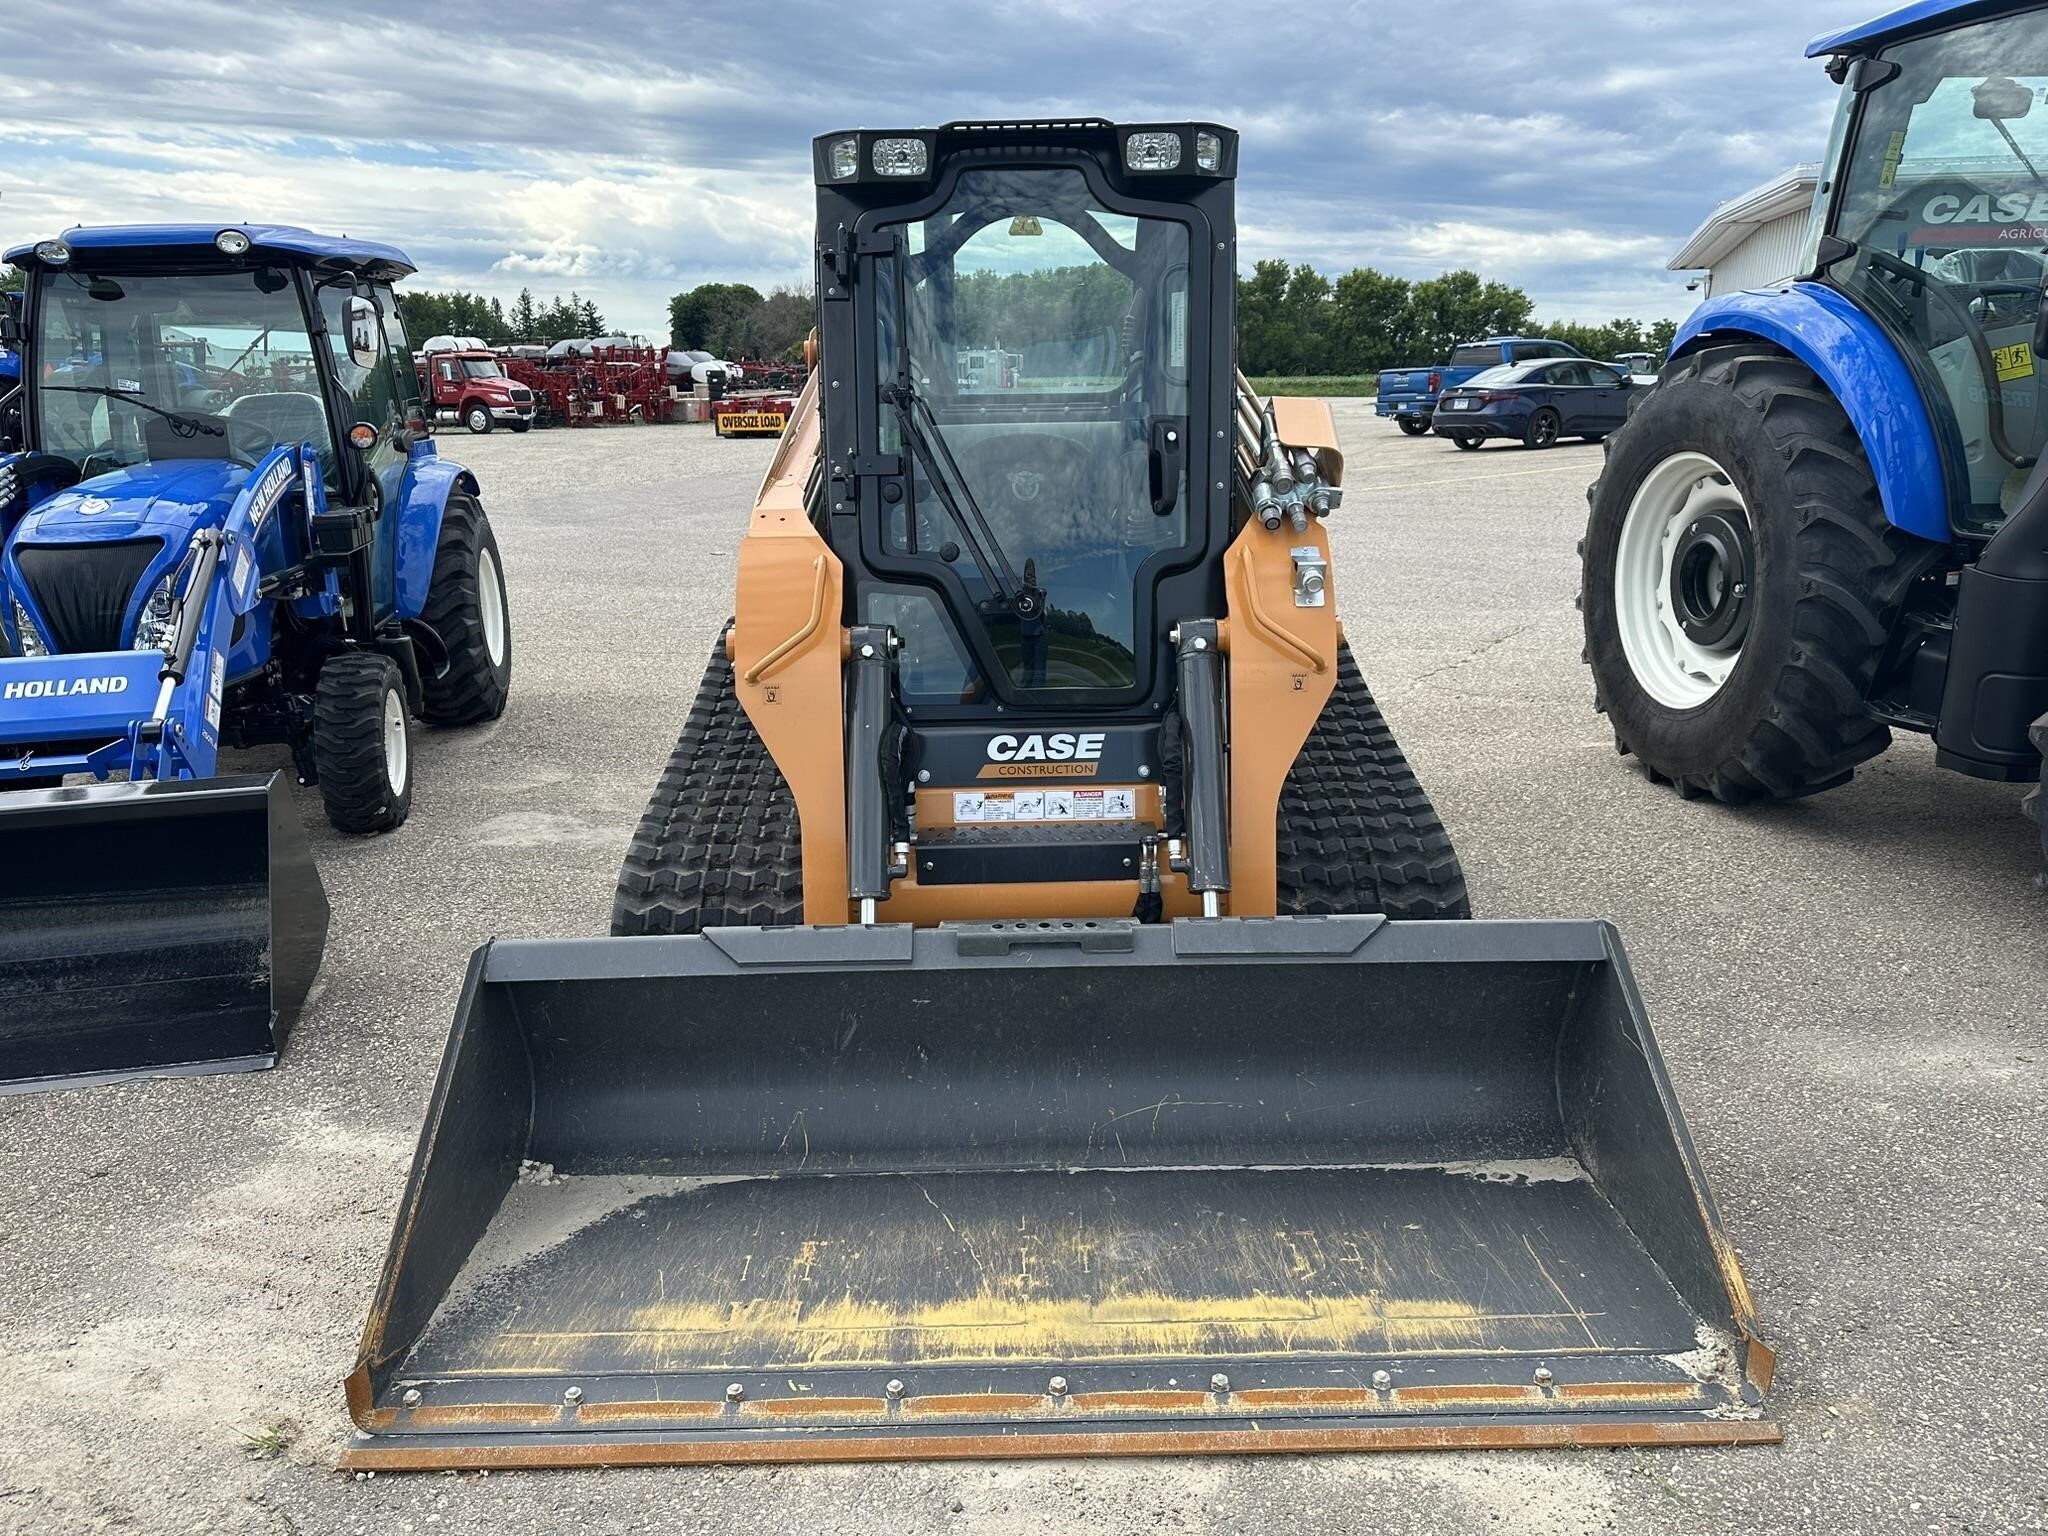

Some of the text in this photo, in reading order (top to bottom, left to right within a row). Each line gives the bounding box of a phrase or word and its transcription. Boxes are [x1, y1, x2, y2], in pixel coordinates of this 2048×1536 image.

[722, 416, 781, 428] OVERSIZE LOAD
[249, 457, 291, 527] NEW HOLLAND
[4, 676, 128, 699] HOLLAND
[987, 733, 1106, 761] CASE
[998, 764, 1094, 775] CONSTRUCTION
